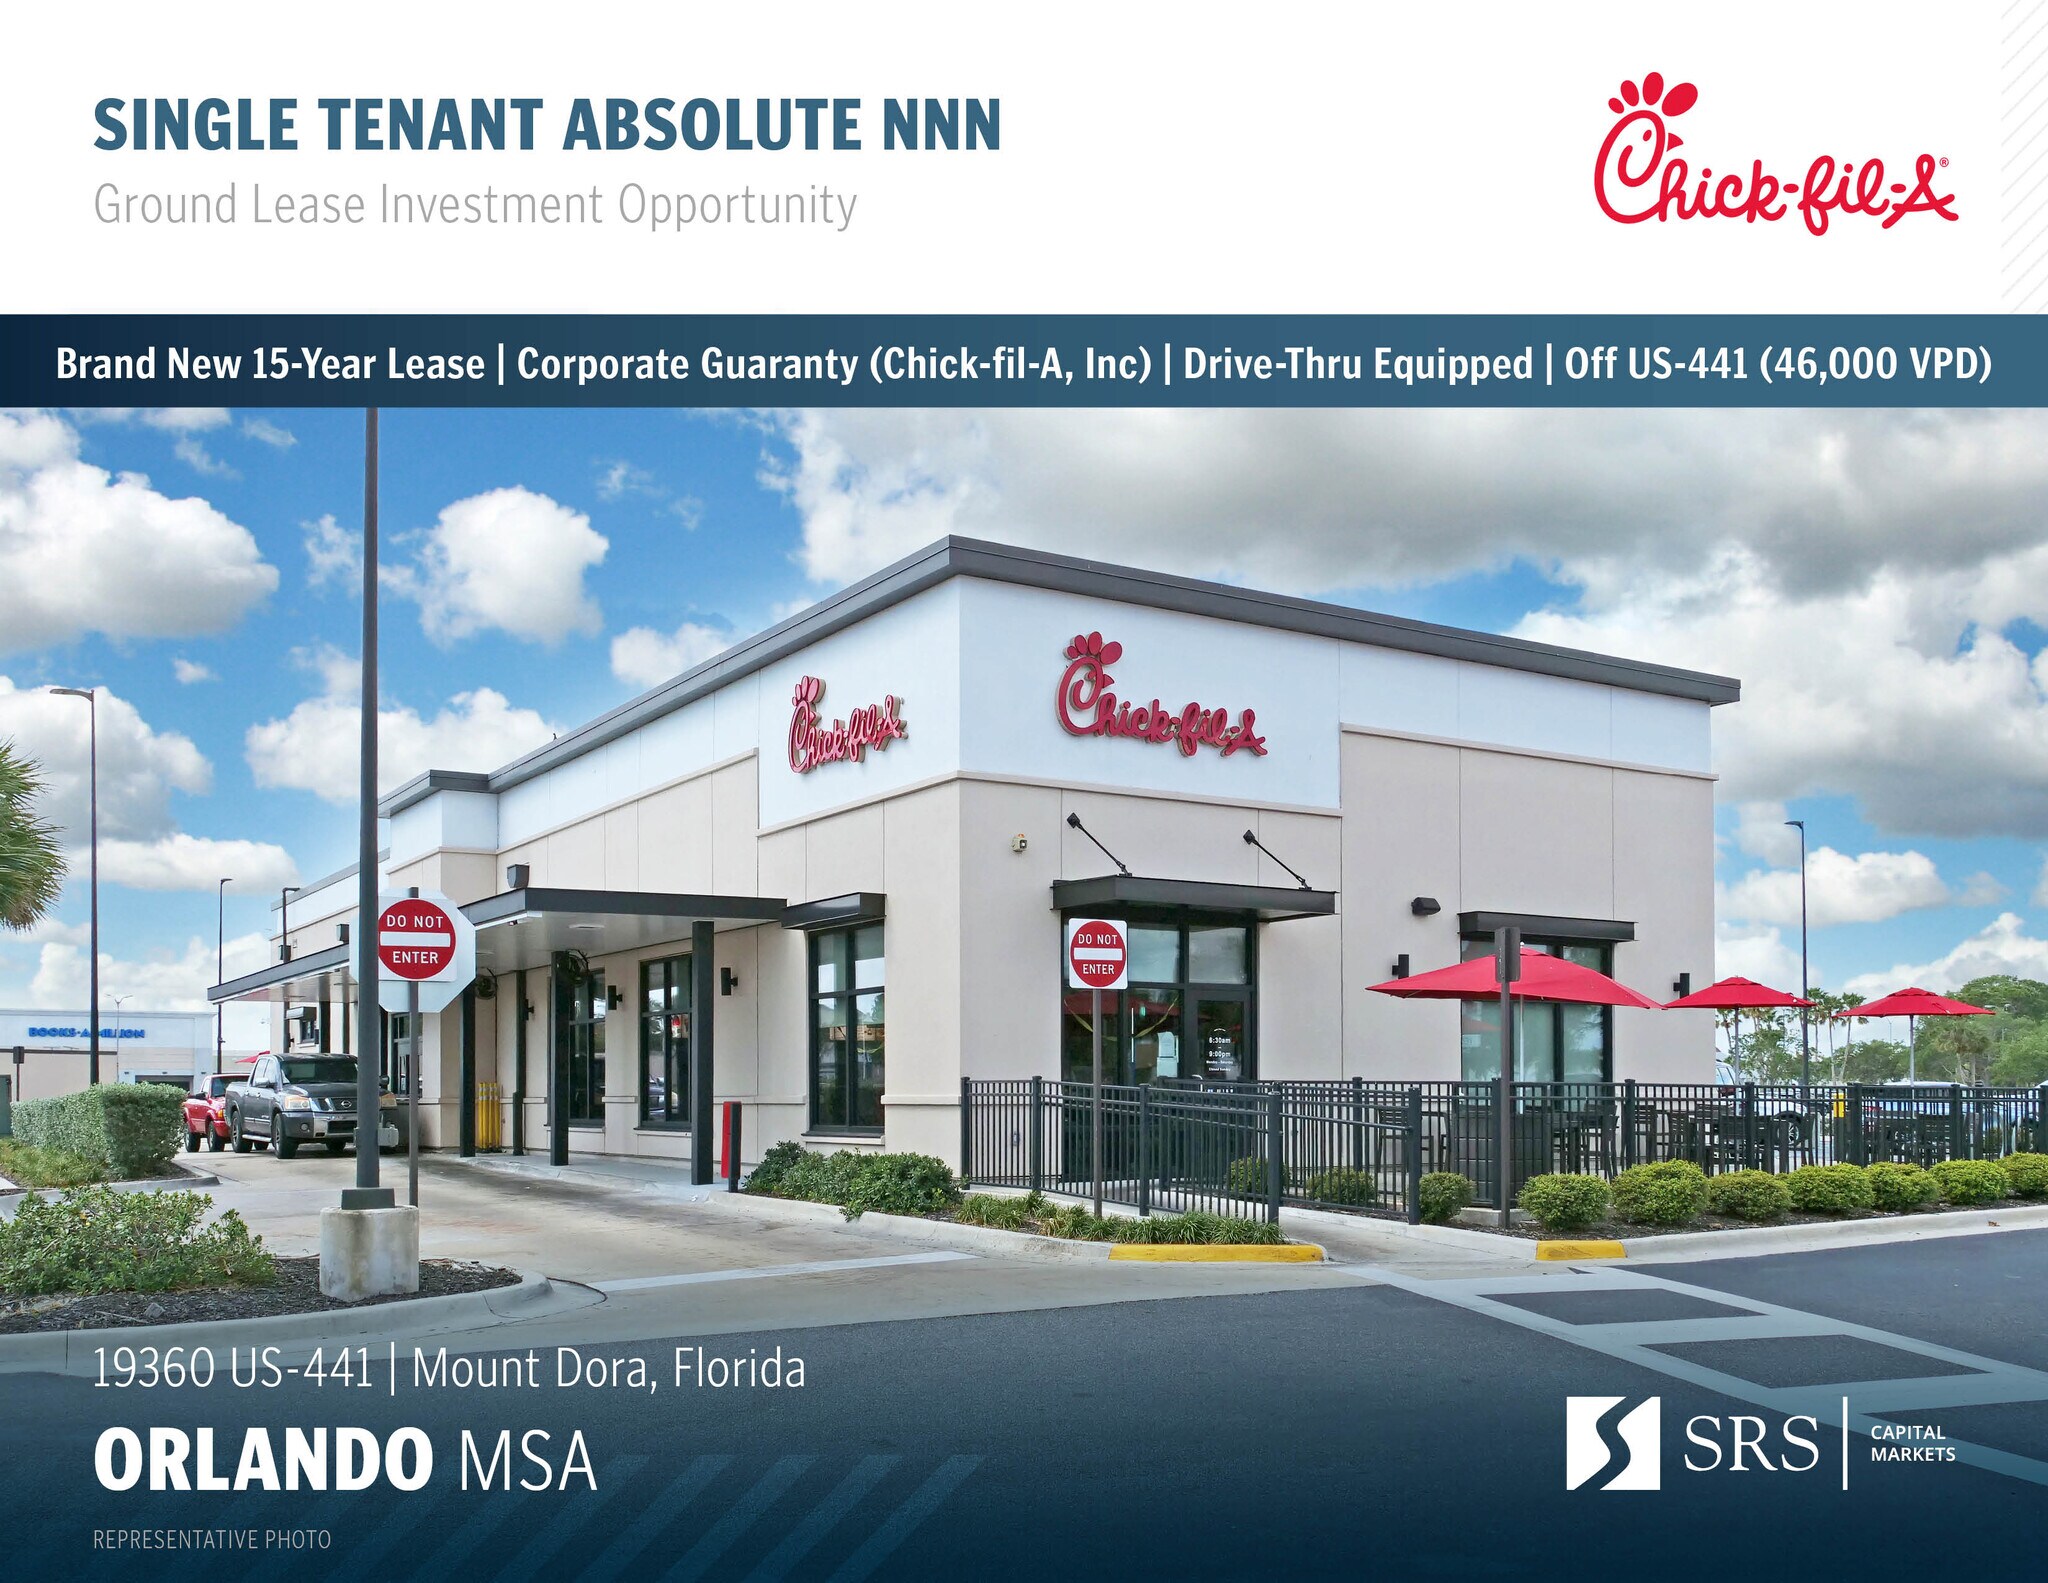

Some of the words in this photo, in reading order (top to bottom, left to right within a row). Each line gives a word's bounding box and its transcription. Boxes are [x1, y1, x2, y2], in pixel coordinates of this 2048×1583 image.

[1056, 631, 1268, 757] Chick-fil-A
[387, 915, 406, 927] DO
[414, 915, 443, 928] NOT
[1078, 933, 1092, 945] DO
[1097, 934, 1117, 945] NOT
[393, 951, 438, 964] ENTER
[1082, 963, 1115, 975] ENTER
